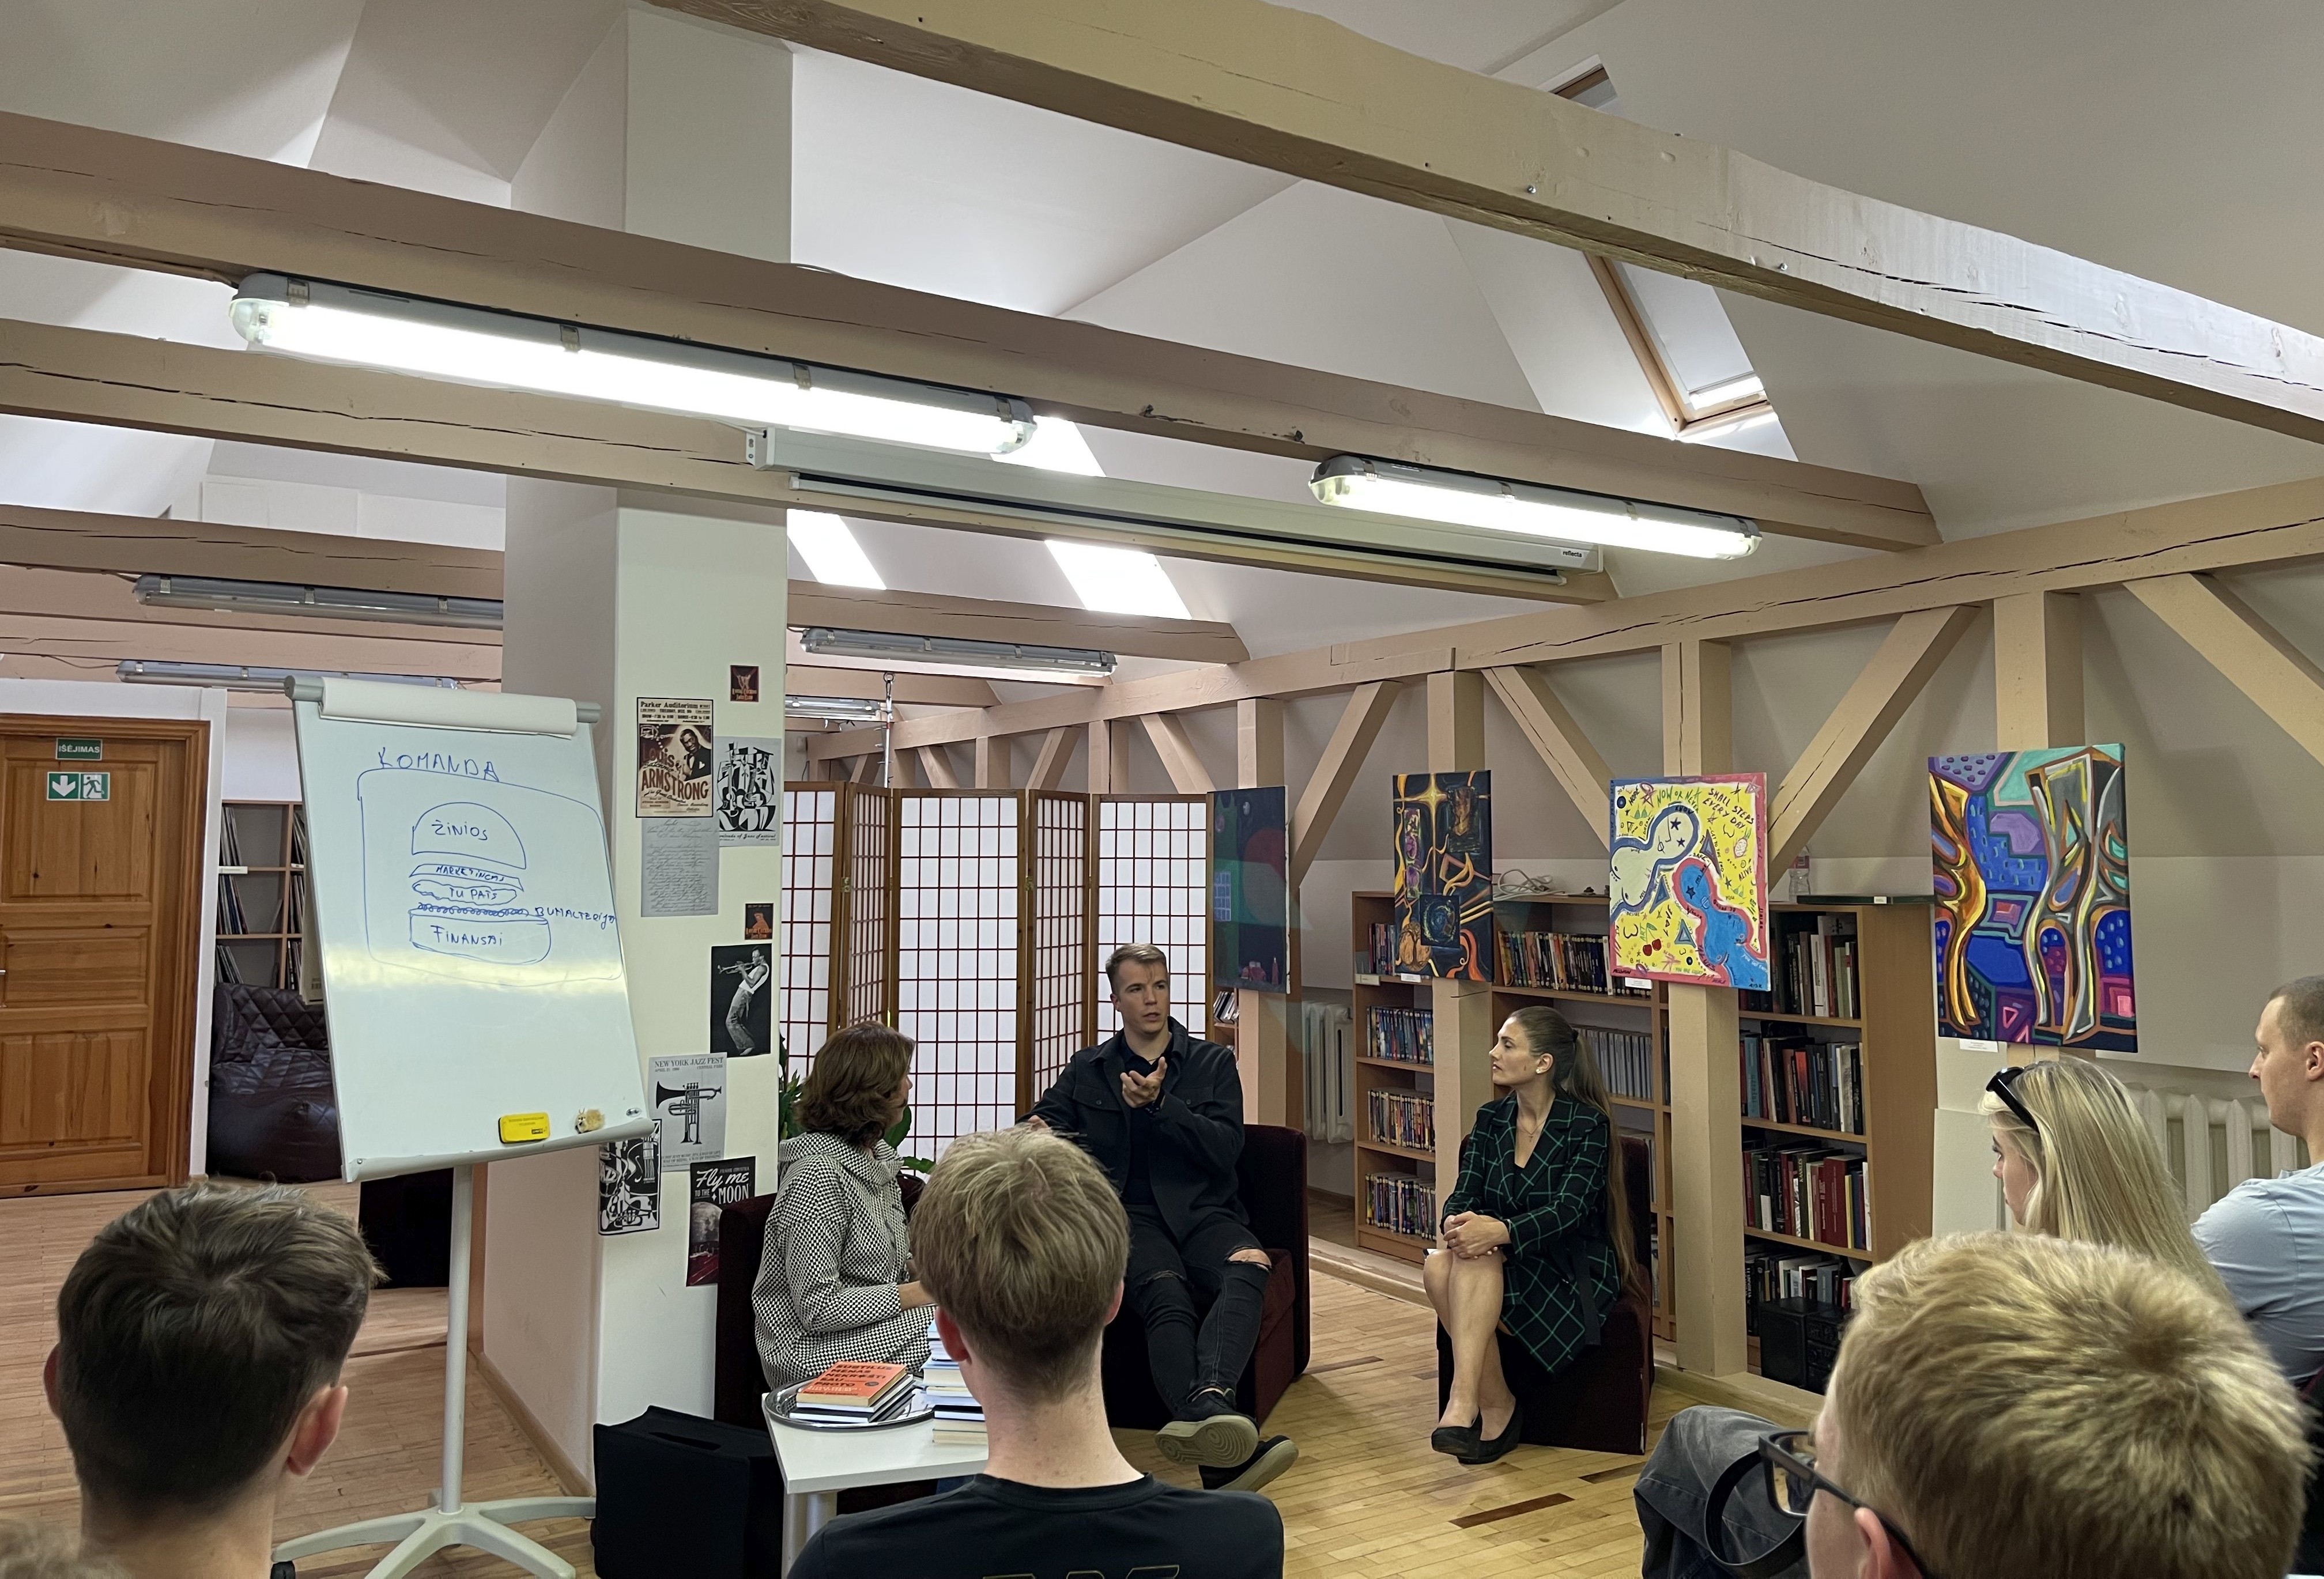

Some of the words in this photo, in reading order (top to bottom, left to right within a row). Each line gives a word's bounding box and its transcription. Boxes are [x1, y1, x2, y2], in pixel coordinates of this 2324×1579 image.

[59, 744, 100, 753] IŠĖJIMAS
[378, 747, 500, 782] KOMANDA
[641, 768, 710, 801] ARMSTRONG
[1657, 785, 1673, 807] NOW
[1674, 791, 1683, 800] OR
[1708, 788, 1730, 807] SMALL
[1731, 806, 1754, 825] STEPS
[1702, 798, 1730, 817] EVERY
[1730, 817, 1746, 829] DAY
[431, 820, 488, 841] ŽINIOS
[1693, 852, 1708, 861] SAFE
[1738, 866, 1753, 881] ALIVE
[450, 887, 463, 898] TU
[696, 1168, 723, 1192] Fly
[725, 1172, 749, 1185] me
[701, 1188, 710, 1196] THE
[718, 1183, 749, 1204] MOON
